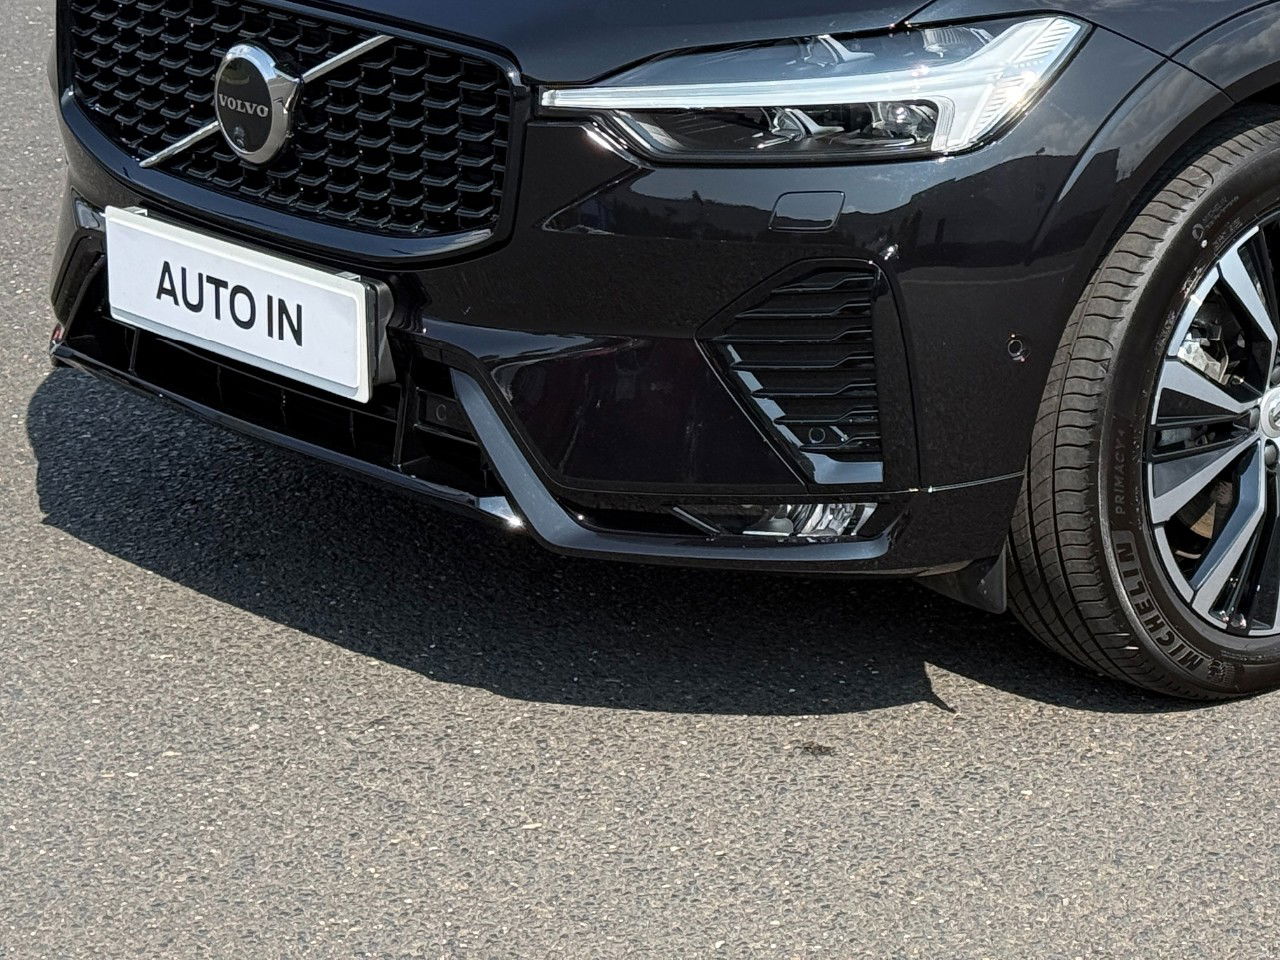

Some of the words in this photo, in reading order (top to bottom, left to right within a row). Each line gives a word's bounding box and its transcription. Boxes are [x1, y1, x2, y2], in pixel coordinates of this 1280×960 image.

[218, 93, 269, 118] VOLVO
[155, 260, 257, 330] AUTO
[266, 294, 303, 347] IN
[1113, 438, 1126, 515] PRIMACY
[1115, 541, 1206, 672] MICHELIN
